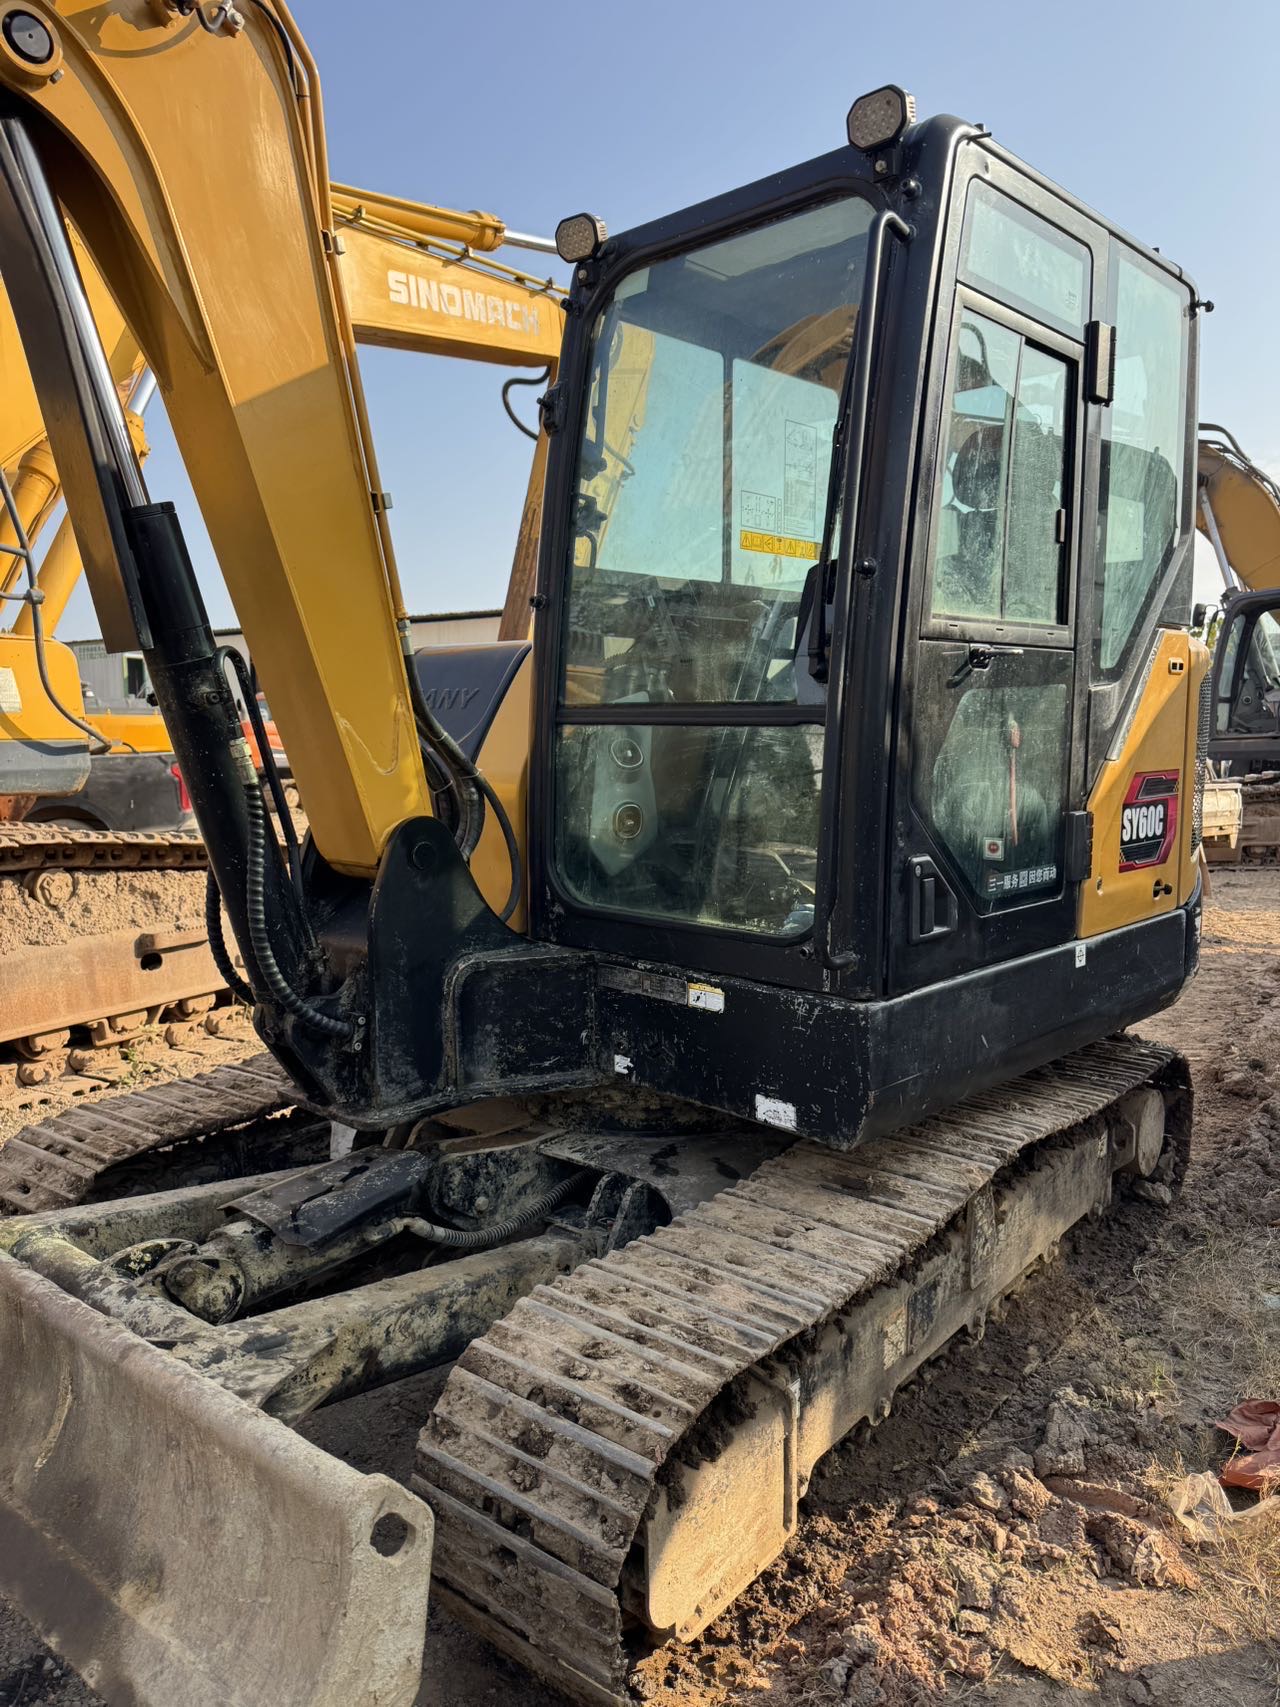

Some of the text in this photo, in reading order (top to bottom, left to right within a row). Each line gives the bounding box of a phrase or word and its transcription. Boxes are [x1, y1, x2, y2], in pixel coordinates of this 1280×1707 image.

[387, 269, 540, 336] SINOMACH
[424, 686, 480, 710] ANY
[1122, 804, 1164, 842] SY60C
